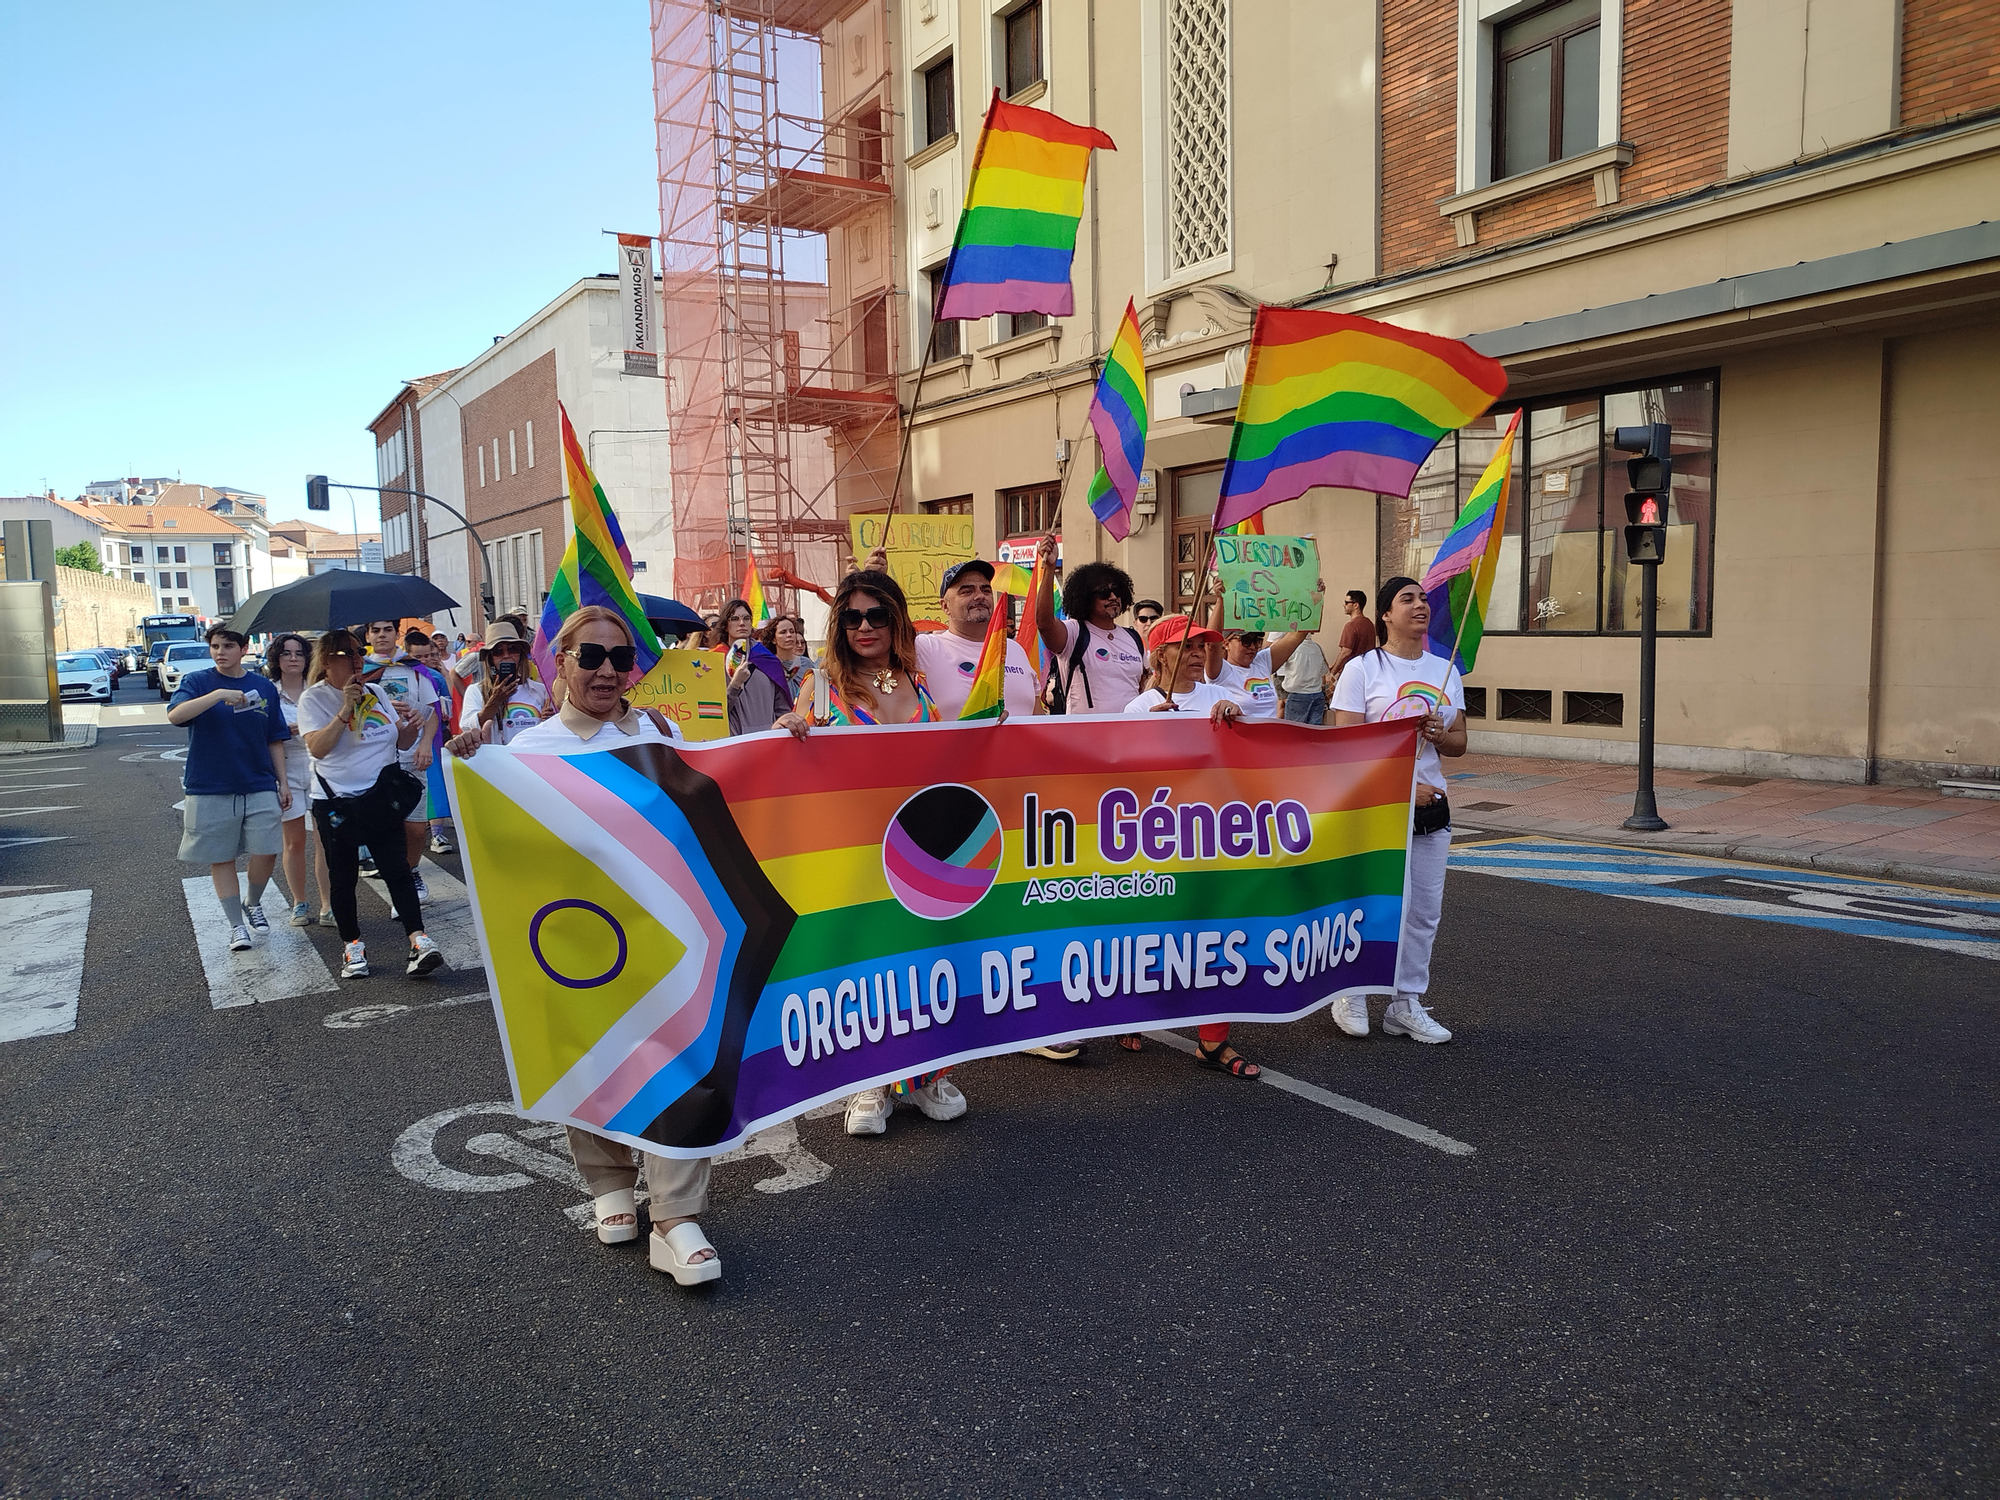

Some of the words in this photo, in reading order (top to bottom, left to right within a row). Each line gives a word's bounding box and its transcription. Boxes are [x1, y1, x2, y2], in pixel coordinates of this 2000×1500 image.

[632, 267, 645, 350] AKIANDAMIOS
[900, 522, 973, 550] ORGULLO
[1251, 570, 1280, 595] ES
[1233, 592, 1312, 621] LIBERTAD
[1004, 665, 1024, 675] nero
[633, 702, 692, 721] ANS
[1023, 792, 1077, 869] In
[1098, 787, 1313, 864] Género
[1023, 870, 1175, 906] Asociación
[781, 958, 957, 1067] ORGULLO
[981, 945, 1037, 1015] DE
[1061, 930, 1247, 1004] QUIENES
[1263, 908, 1365, 987] SOMOS
